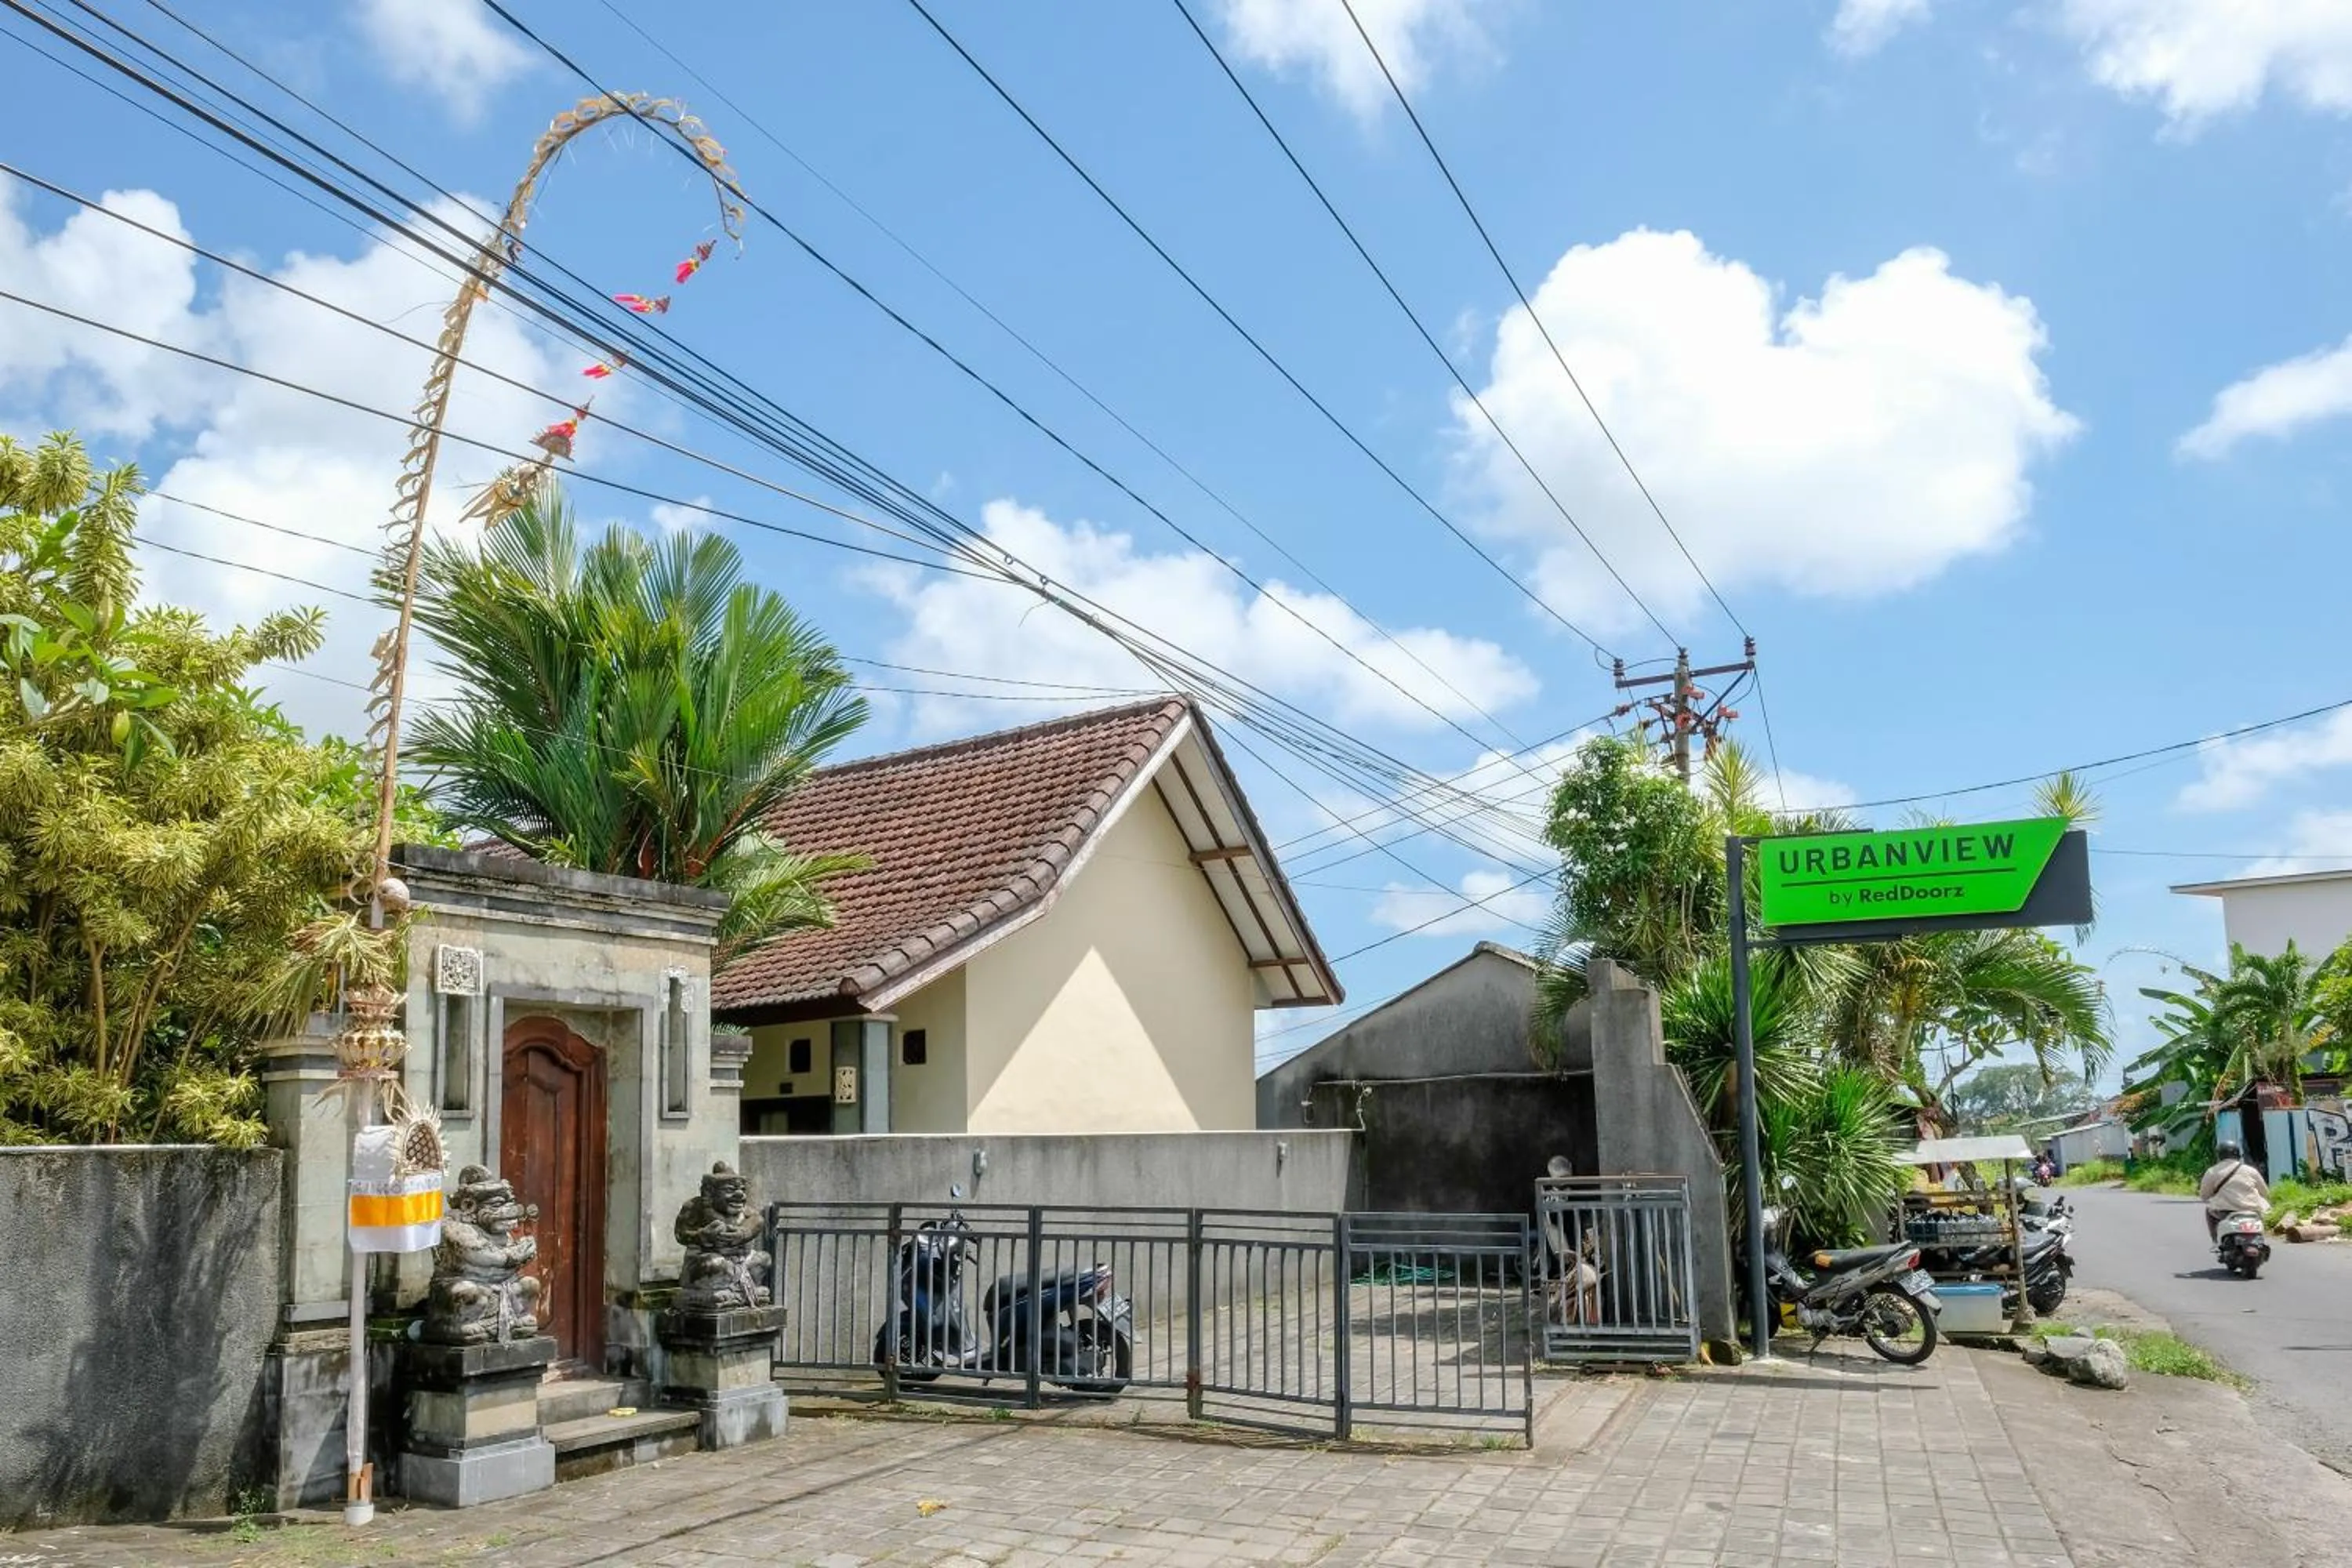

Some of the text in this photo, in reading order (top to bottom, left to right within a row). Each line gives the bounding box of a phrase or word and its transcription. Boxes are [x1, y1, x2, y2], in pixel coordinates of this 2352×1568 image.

[1779, 833, 2015, 876] URBANVIEW
[1829, 884, 1965, 906] by RedDoorz
